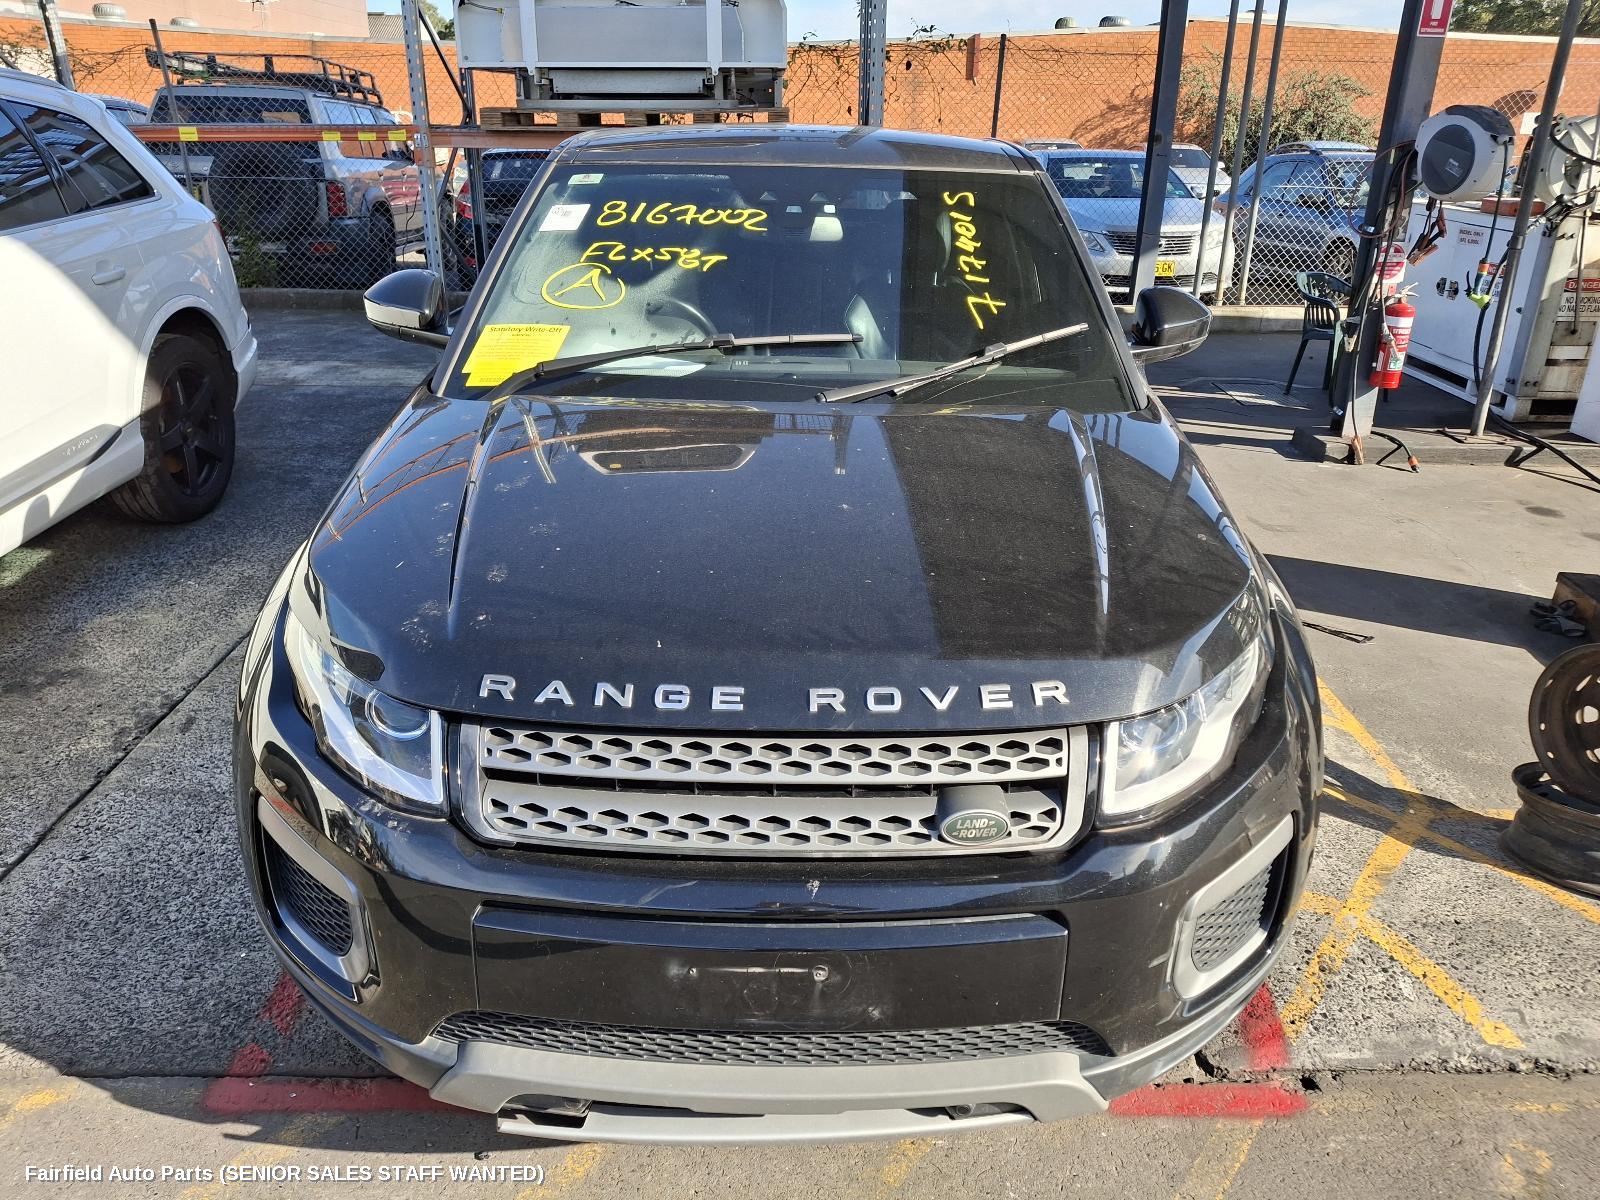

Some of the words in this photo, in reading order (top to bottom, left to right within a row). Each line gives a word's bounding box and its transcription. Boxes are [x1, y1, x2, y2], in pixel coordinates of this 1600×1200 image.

[596, 200, 768, 231] 8167002
[553, 268, 607, 302] A
[1568, 281, 1600, 289] DNGE
[1566, 304, 1587, 312] NAED
[479, 673, 745, 711] RANGE
[807, 679, 1071, 713] ROVER
[956, 818, 989, 829] LAND
[958, 827, 998, 838] ROVER
